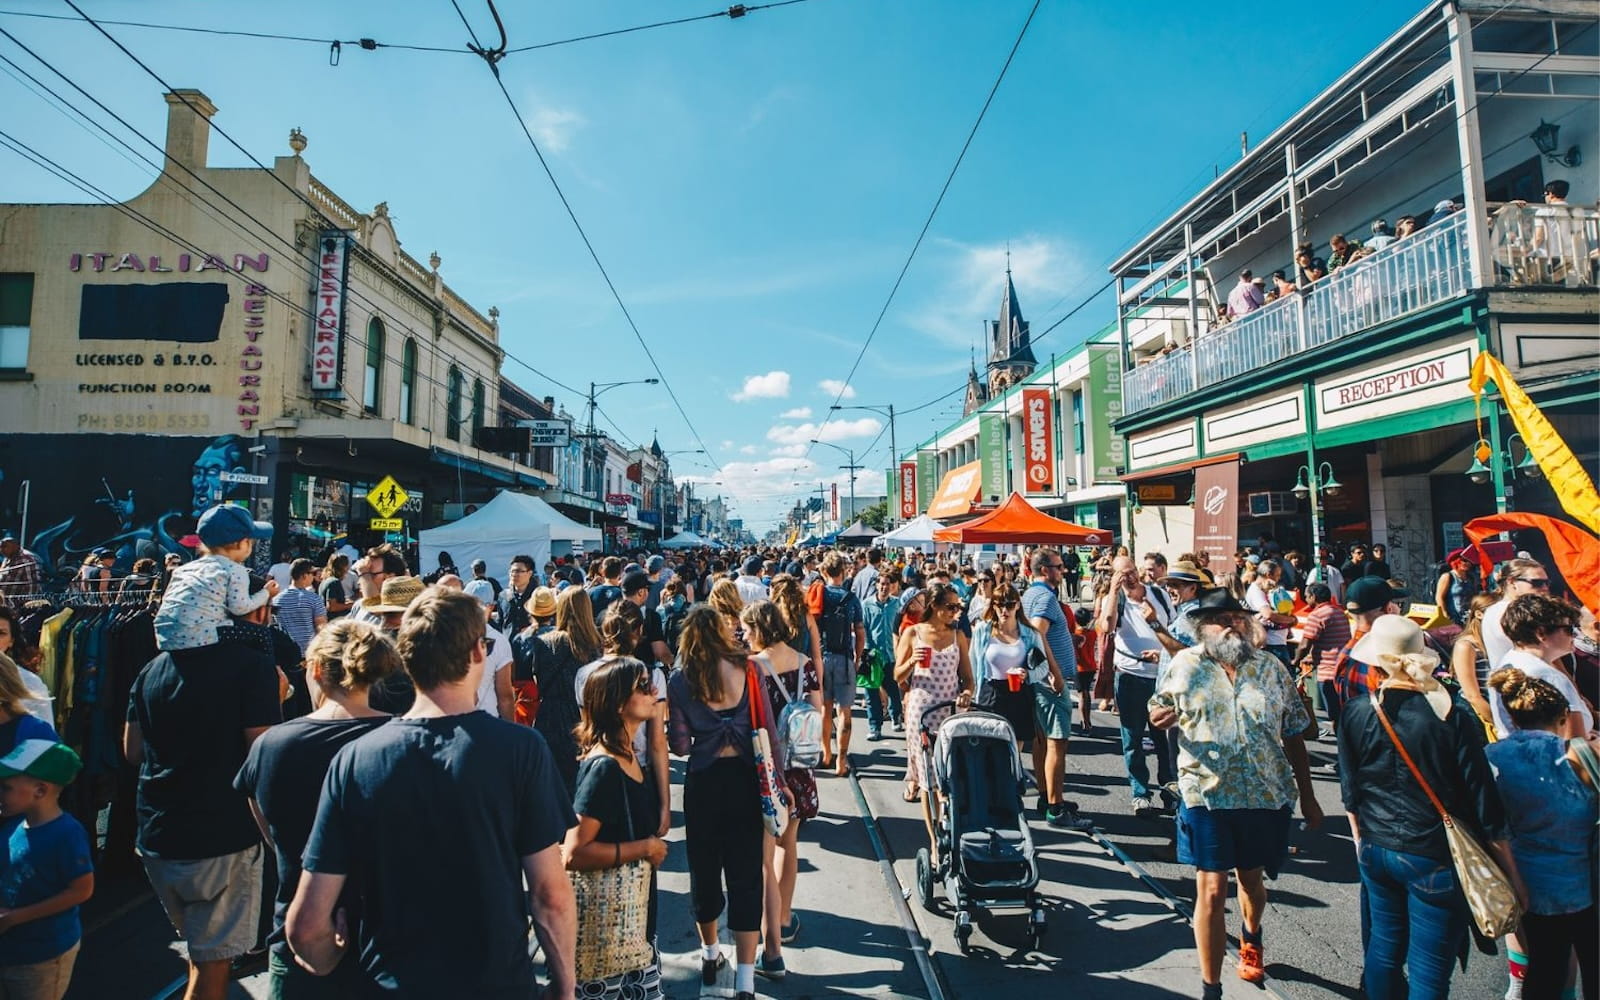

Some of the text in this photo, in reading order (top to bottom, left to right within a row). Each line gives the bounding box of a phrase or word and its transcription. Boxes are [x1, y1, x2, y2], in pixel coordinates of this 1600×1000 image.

[69, 252, 269, 272] ITALIAN
[315, 254, 340, 384] RESTAURANT
[76, 353, 217, 366] LICENSED & B.Y.O.
[237, 284, 267, 430] RESTAURANT
[1104, 352, 1121, 393] here
[78, 383, 212, 394] FUNCTION ROOM
[1339, 361, 1445, 405] RECEPTION
[77, 413, 107, 429] PH:
[1029, 398, 1047, 462] savers
[988, 417, 1002, 493] donate here
[904, 468, 913, 502] savers
